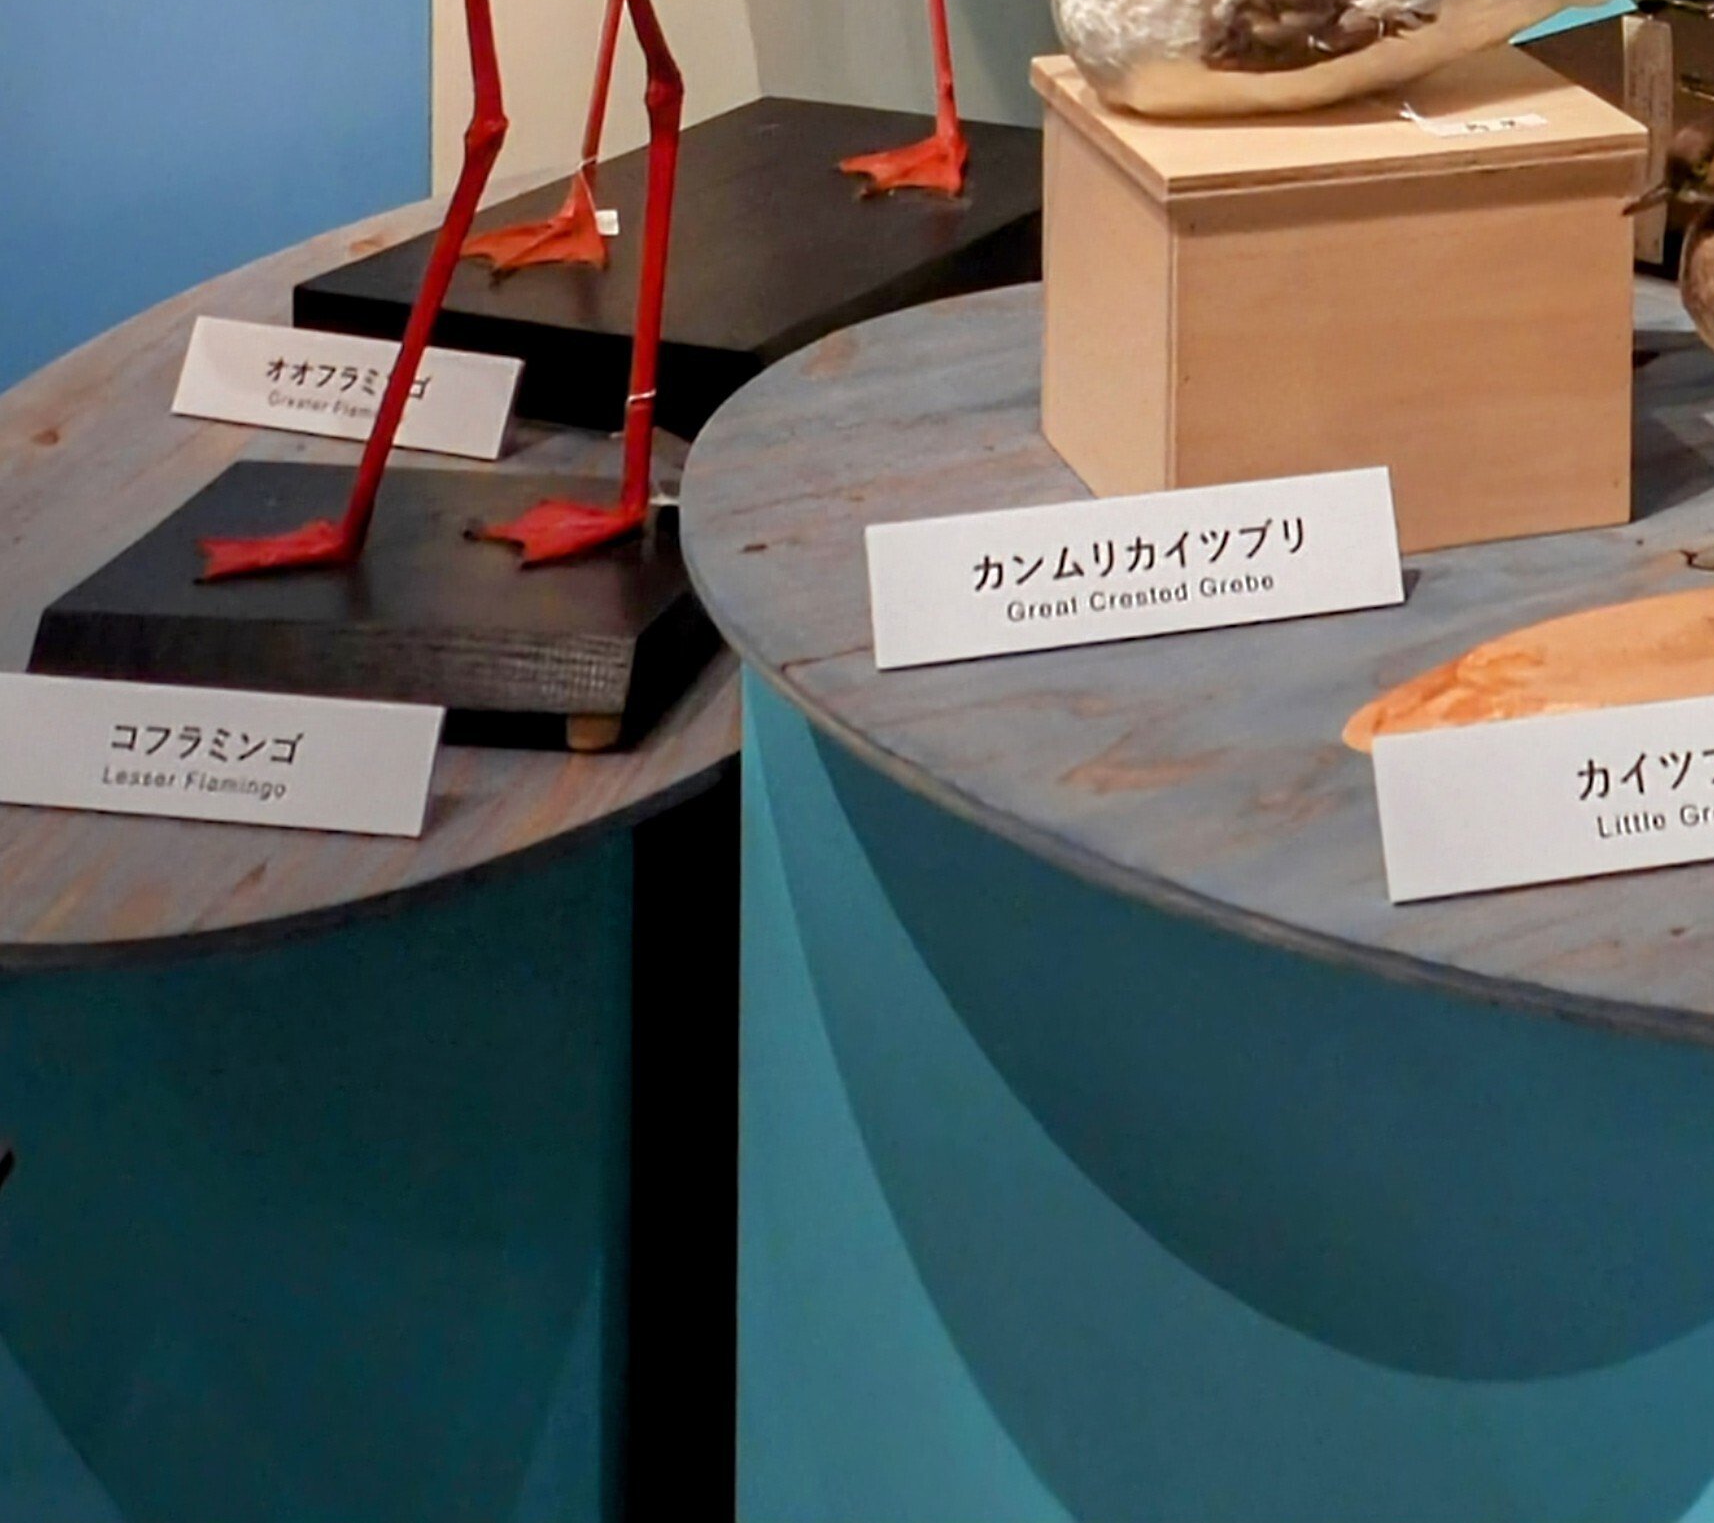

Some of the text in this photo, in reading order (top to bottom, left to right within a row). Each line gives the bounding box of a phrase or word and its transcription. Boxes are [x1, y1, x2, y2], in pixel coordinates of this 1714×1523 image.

[266, 356, 433, 400] オオフラミゴ
[972, 515, 1305, 592] カンムリカイツブリ
[1007, 570, 1275, 622] Great Crested Grebe
[110, 724, 305, 765] コフラミンゴ
[102, 766, 288, 800] Lesser Flamingo
[1596, 809, 1667, 839] Little
